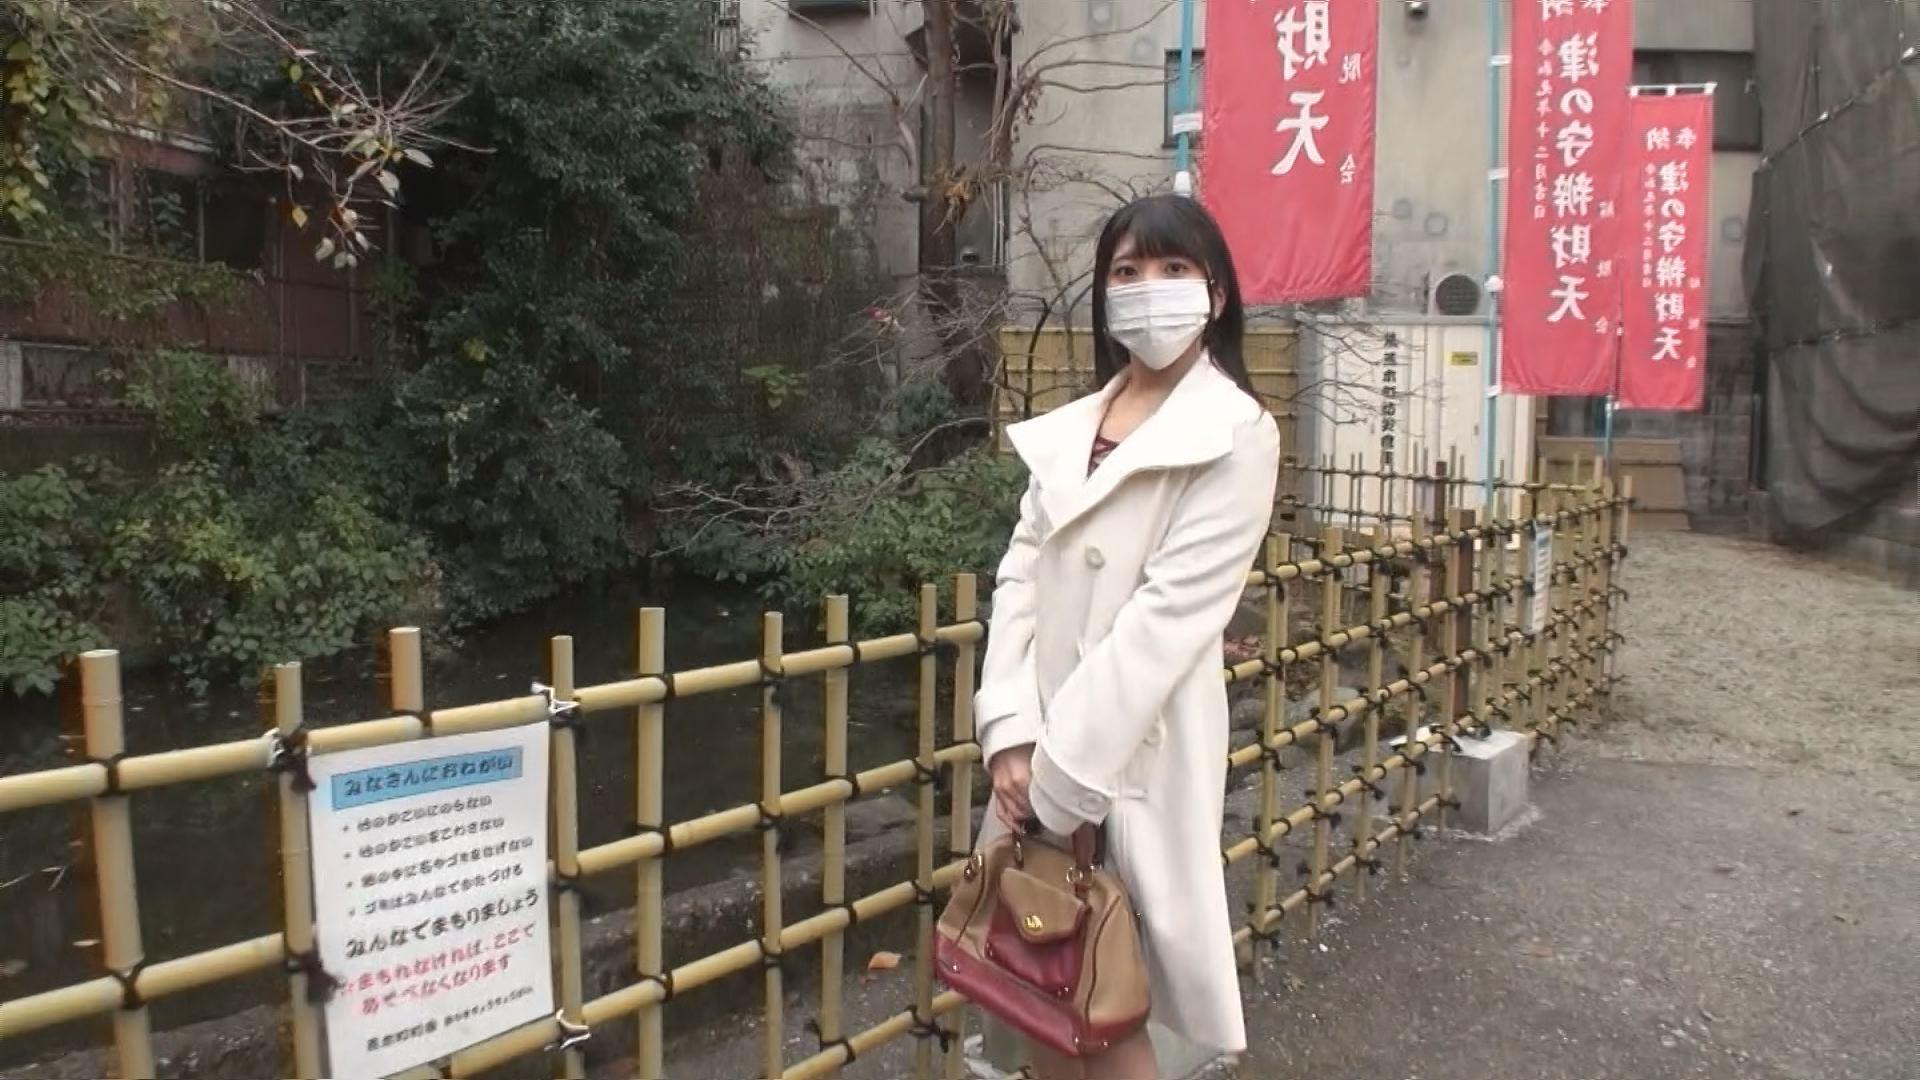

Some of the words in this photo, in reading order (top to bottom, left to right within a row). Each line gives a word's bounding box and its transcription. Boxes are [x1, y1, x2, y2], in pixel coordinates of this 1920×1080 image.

[343, 755, 513, 797] みなさんにおねがい
[345, 888, 539, 960] みんなでまもりましょう
